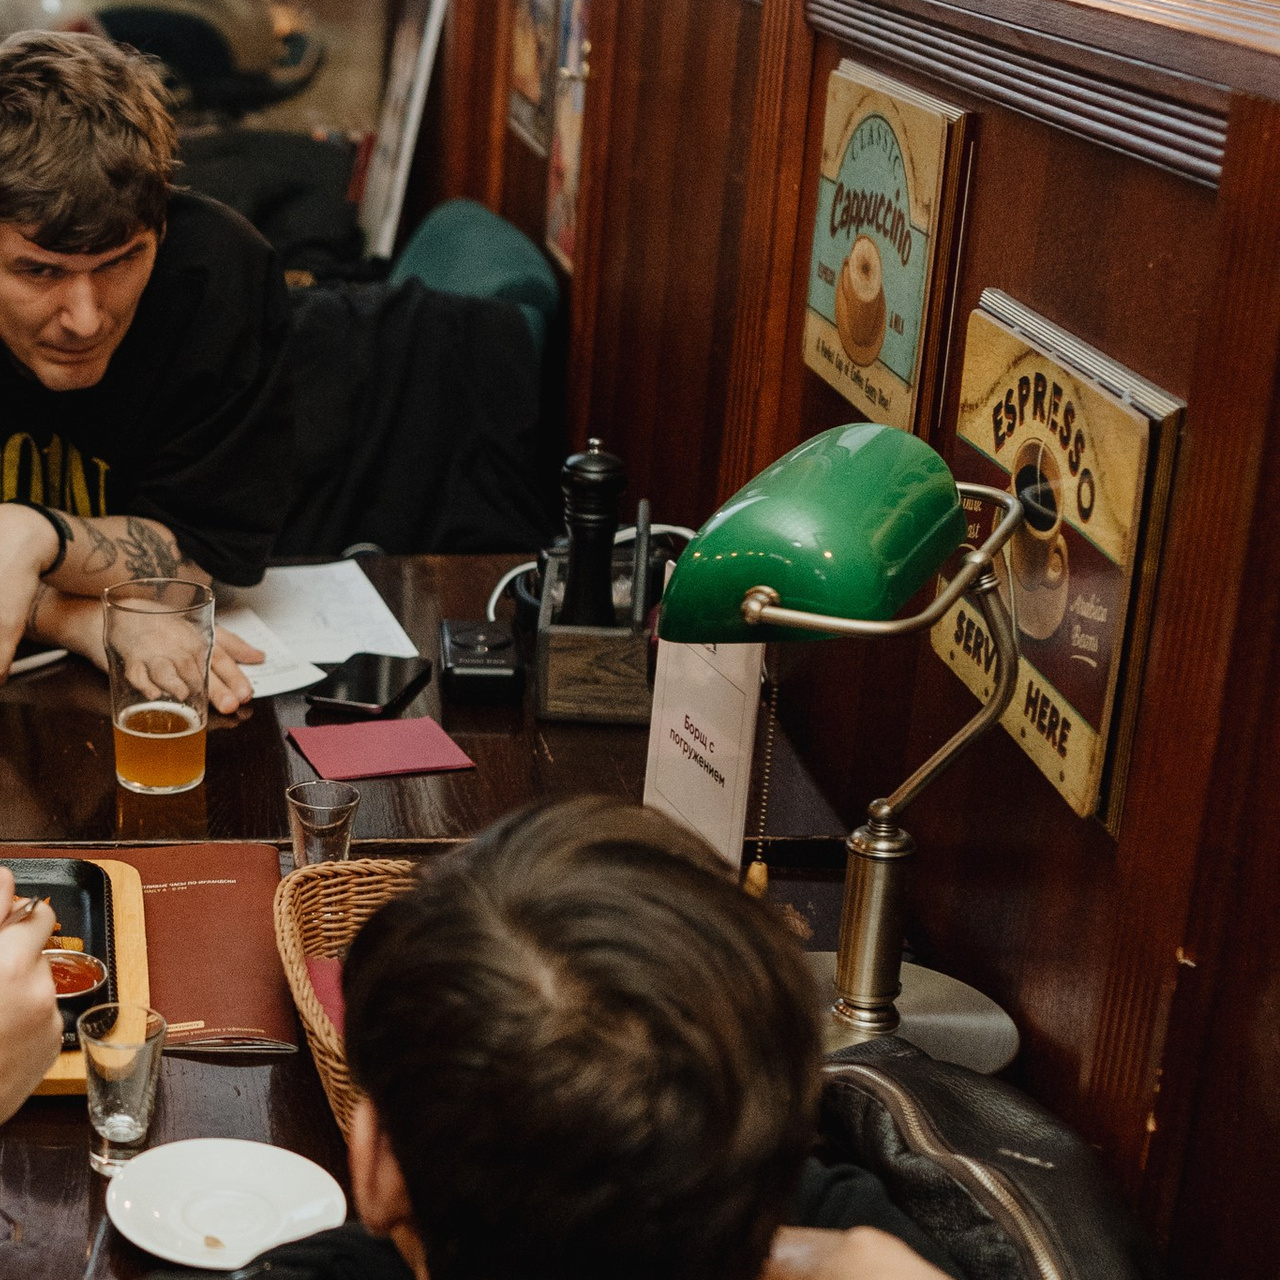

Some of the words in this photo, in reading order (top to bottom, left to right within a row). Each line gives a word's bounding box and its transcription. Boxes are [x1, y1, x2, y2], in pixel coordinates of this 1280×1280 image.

[850, 122, 902, 181] CLASSIC
[829, 181, 913, 267] Cappuccino
[991, 371, 1096, 525] ESPRESSO
[954, 609, 999, 682] SERV
[1023, 679, 1072, 760] HERE
[669, 727, 726, 788] погружением
[684, 714, 708, 750] Борщ
[709, 741, 715, 754] с
[143, 882, 168, 890] ТЛИВЫЕ
